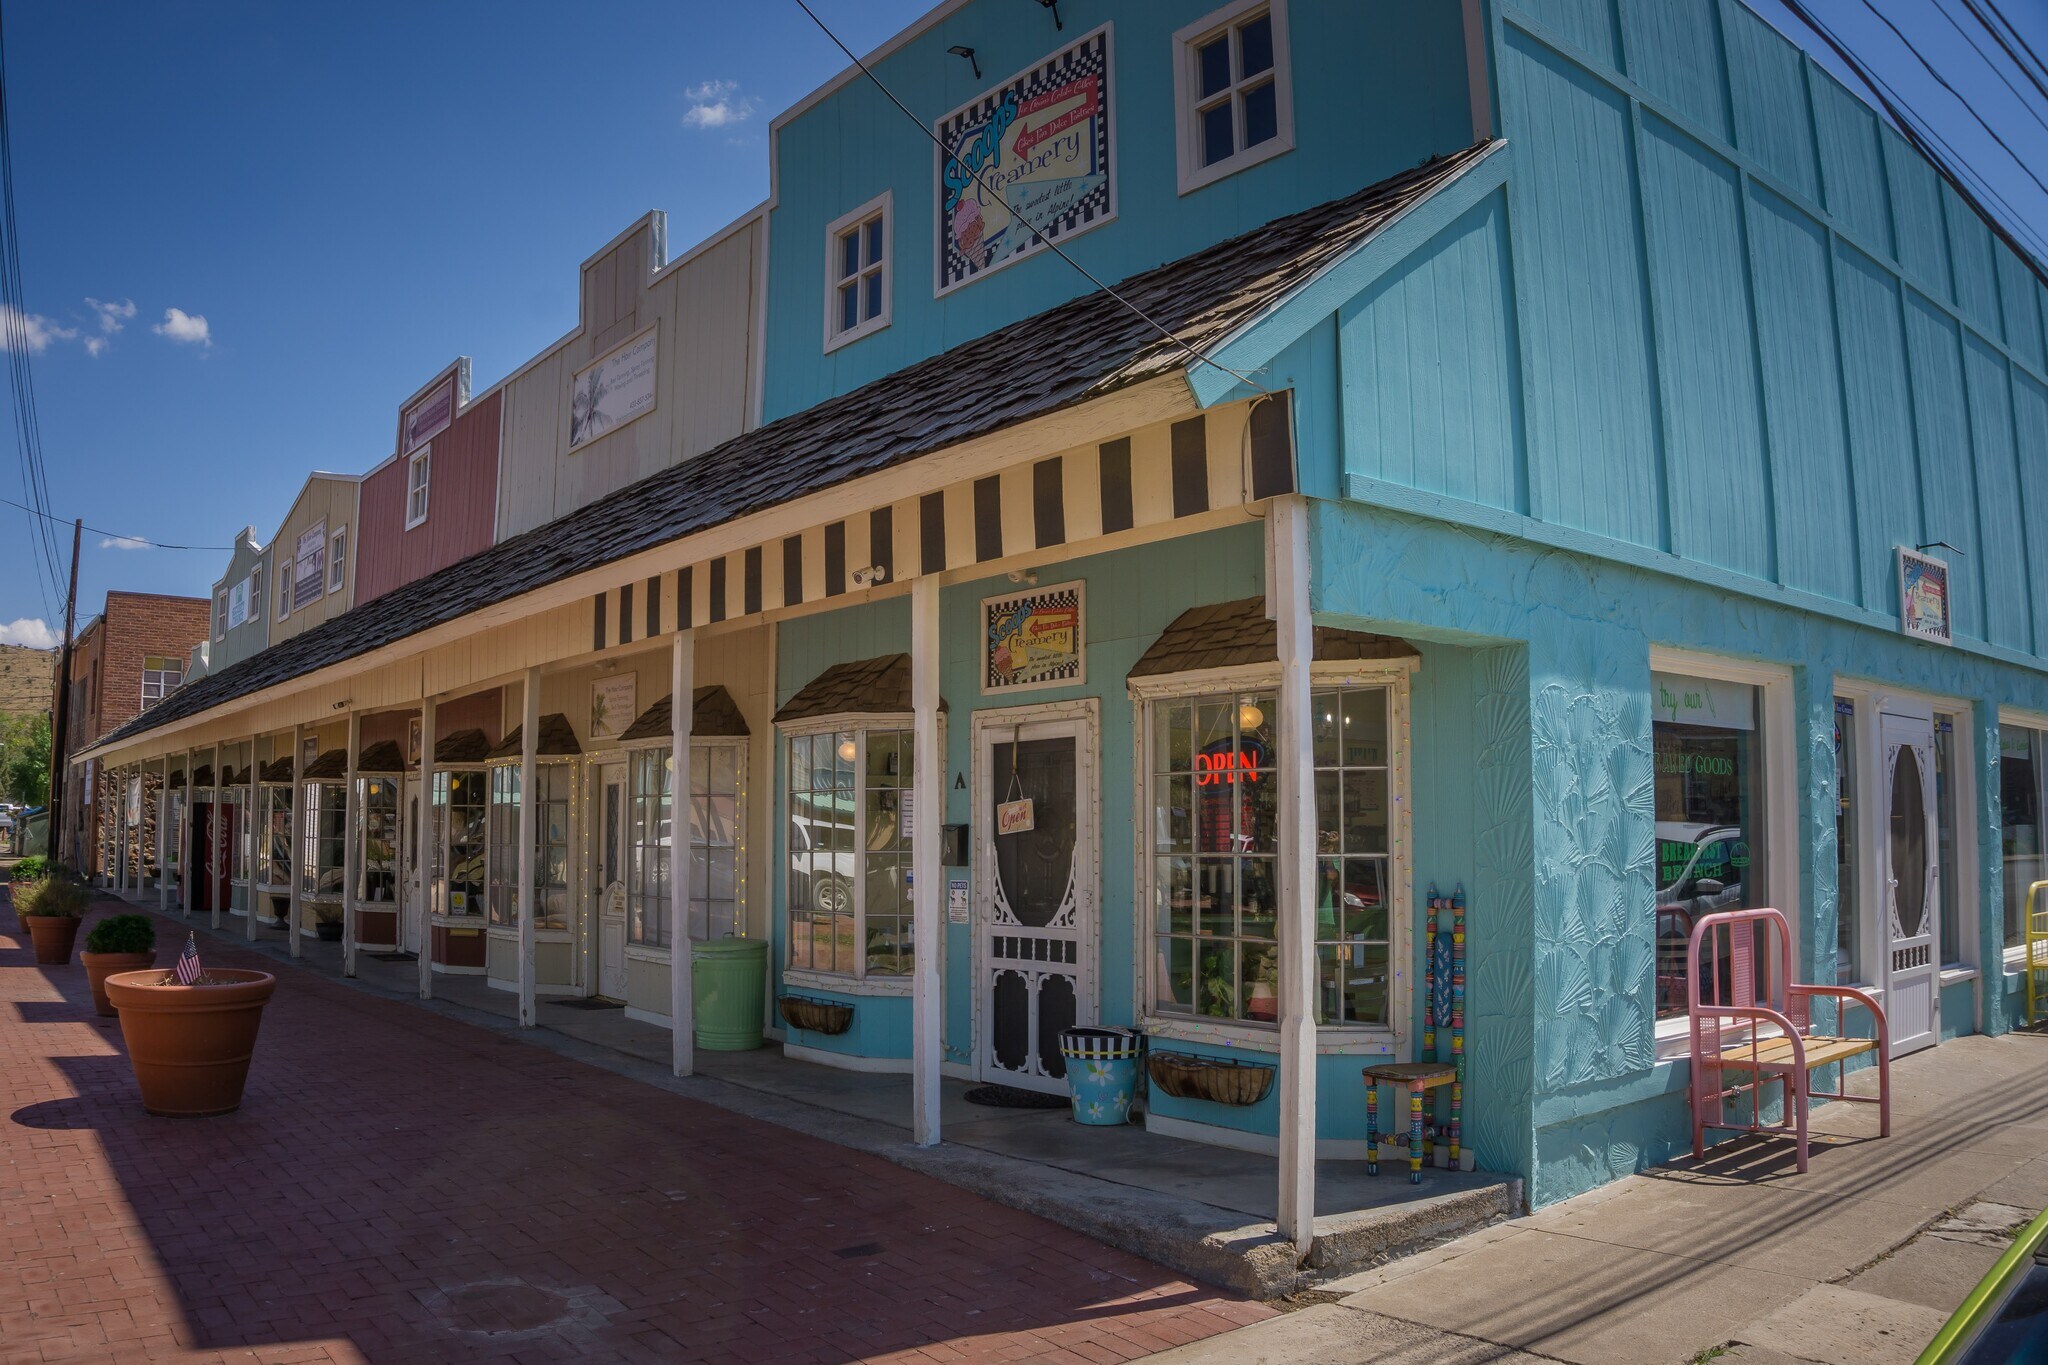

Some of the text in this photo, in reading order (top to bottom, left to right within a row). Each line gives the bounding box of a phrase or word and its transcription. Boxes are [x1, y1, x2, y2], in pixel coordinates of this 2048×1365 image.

[944, 90, 1017, 212] Scoops
[977, 131, 1080, 207] Creamery
[1054, 179, 1073, 196] little
[989, 600, 1034, 650] Scoops
[1008, 631, 1067, 653] Creamery
[1659, 680, 1703, 721] try our
[1195, 750, 1257, 786] OPEN
[1695, 754, 1733, 776] GOODS
[954, 771, 967, 789] A
[1002, 809, 1026, 831] Open
[1662, 840, 1722, 863] BREAKAST
